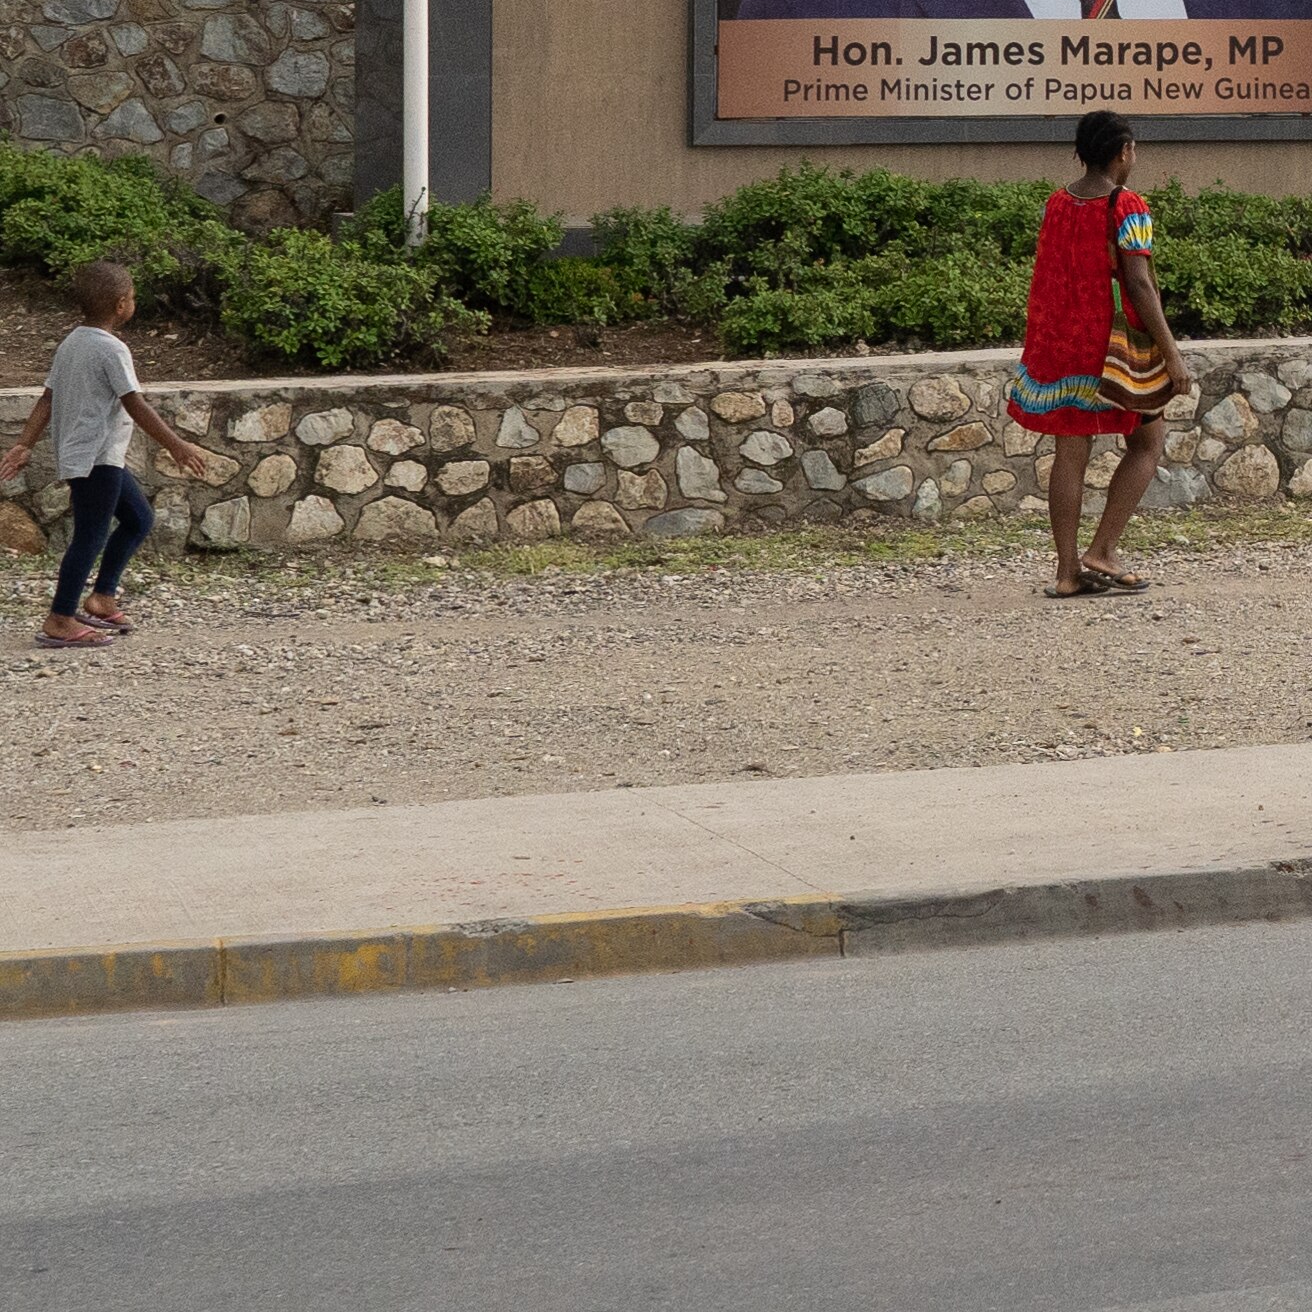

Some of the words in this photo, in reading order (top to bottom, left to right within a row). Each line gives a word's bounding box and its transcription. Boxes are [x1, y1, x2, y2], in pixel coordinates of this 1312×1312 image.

[812, 35, 903, 67] Hon.
[918, 35, 1045, 67] James
[1060, 35, 1213, 71] Marape,
[1228, 35, 1284, 65] MP
[783, 78, 868, 102] Prime
[880, 77, 994, 102] Minister
[1006, 77, 1035, 101] of
[1045, 78, 1132, 105] Papua
[1143, 77, 1203, 100] New
[1214, 76, 1311, 100] Guinea
